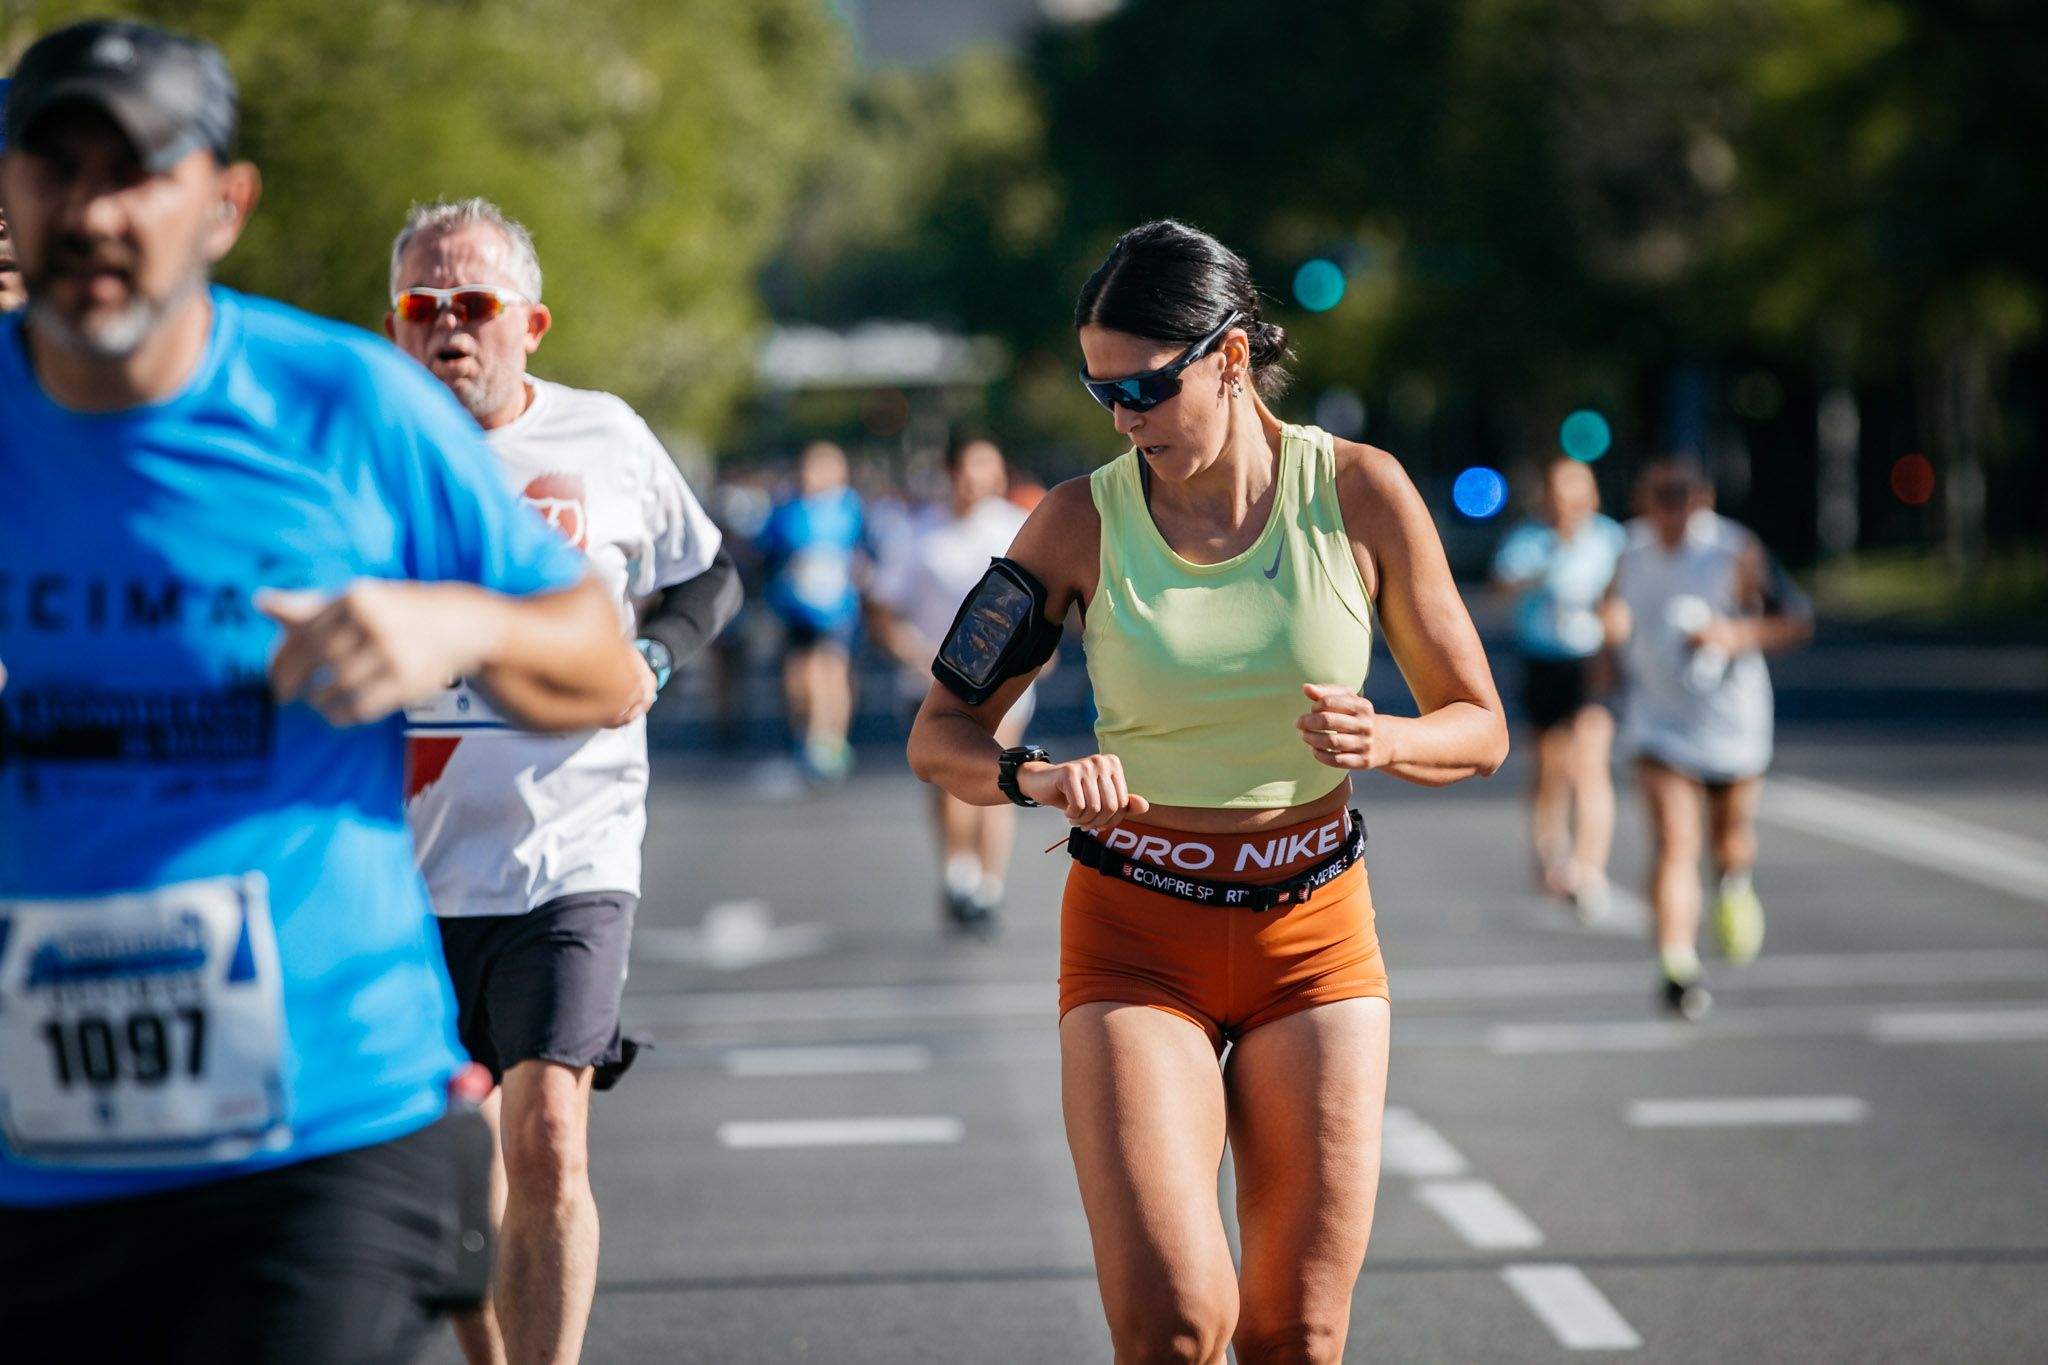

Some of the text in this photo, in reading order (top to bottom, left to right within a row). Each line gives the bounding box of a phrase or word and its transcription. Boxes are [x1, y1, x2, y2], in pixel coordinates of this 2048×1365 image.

[1105, 827, 1215, 870] PRO
[1233, 819, 1340, 872] NIKE
[44, 1007, 208, 1087] 1097
